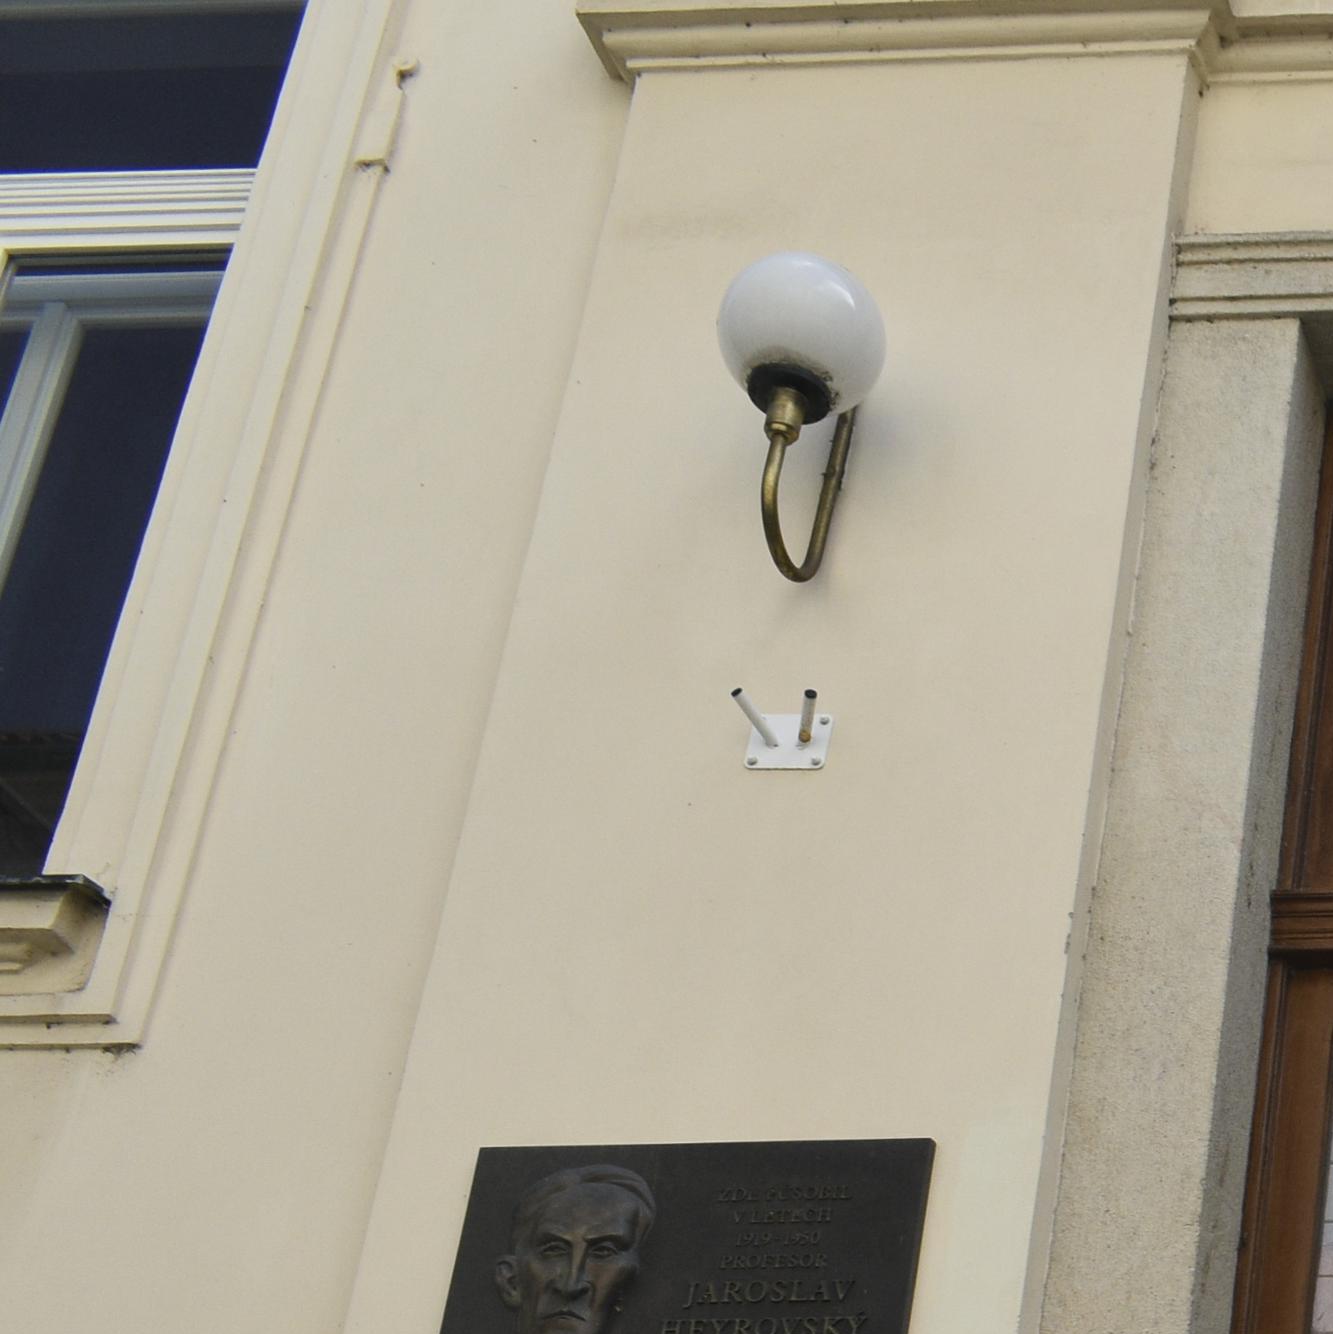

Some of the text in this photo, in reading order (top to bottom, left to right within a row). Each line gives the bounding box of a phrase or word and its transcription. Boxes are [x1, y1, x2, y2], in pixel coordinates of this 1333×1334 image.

[748, 1206, 834, 1225] LETECH
[718, 1252, 830, 1271] PROFESOR
[681, 1278, 857, 1311] JAROSLAV
